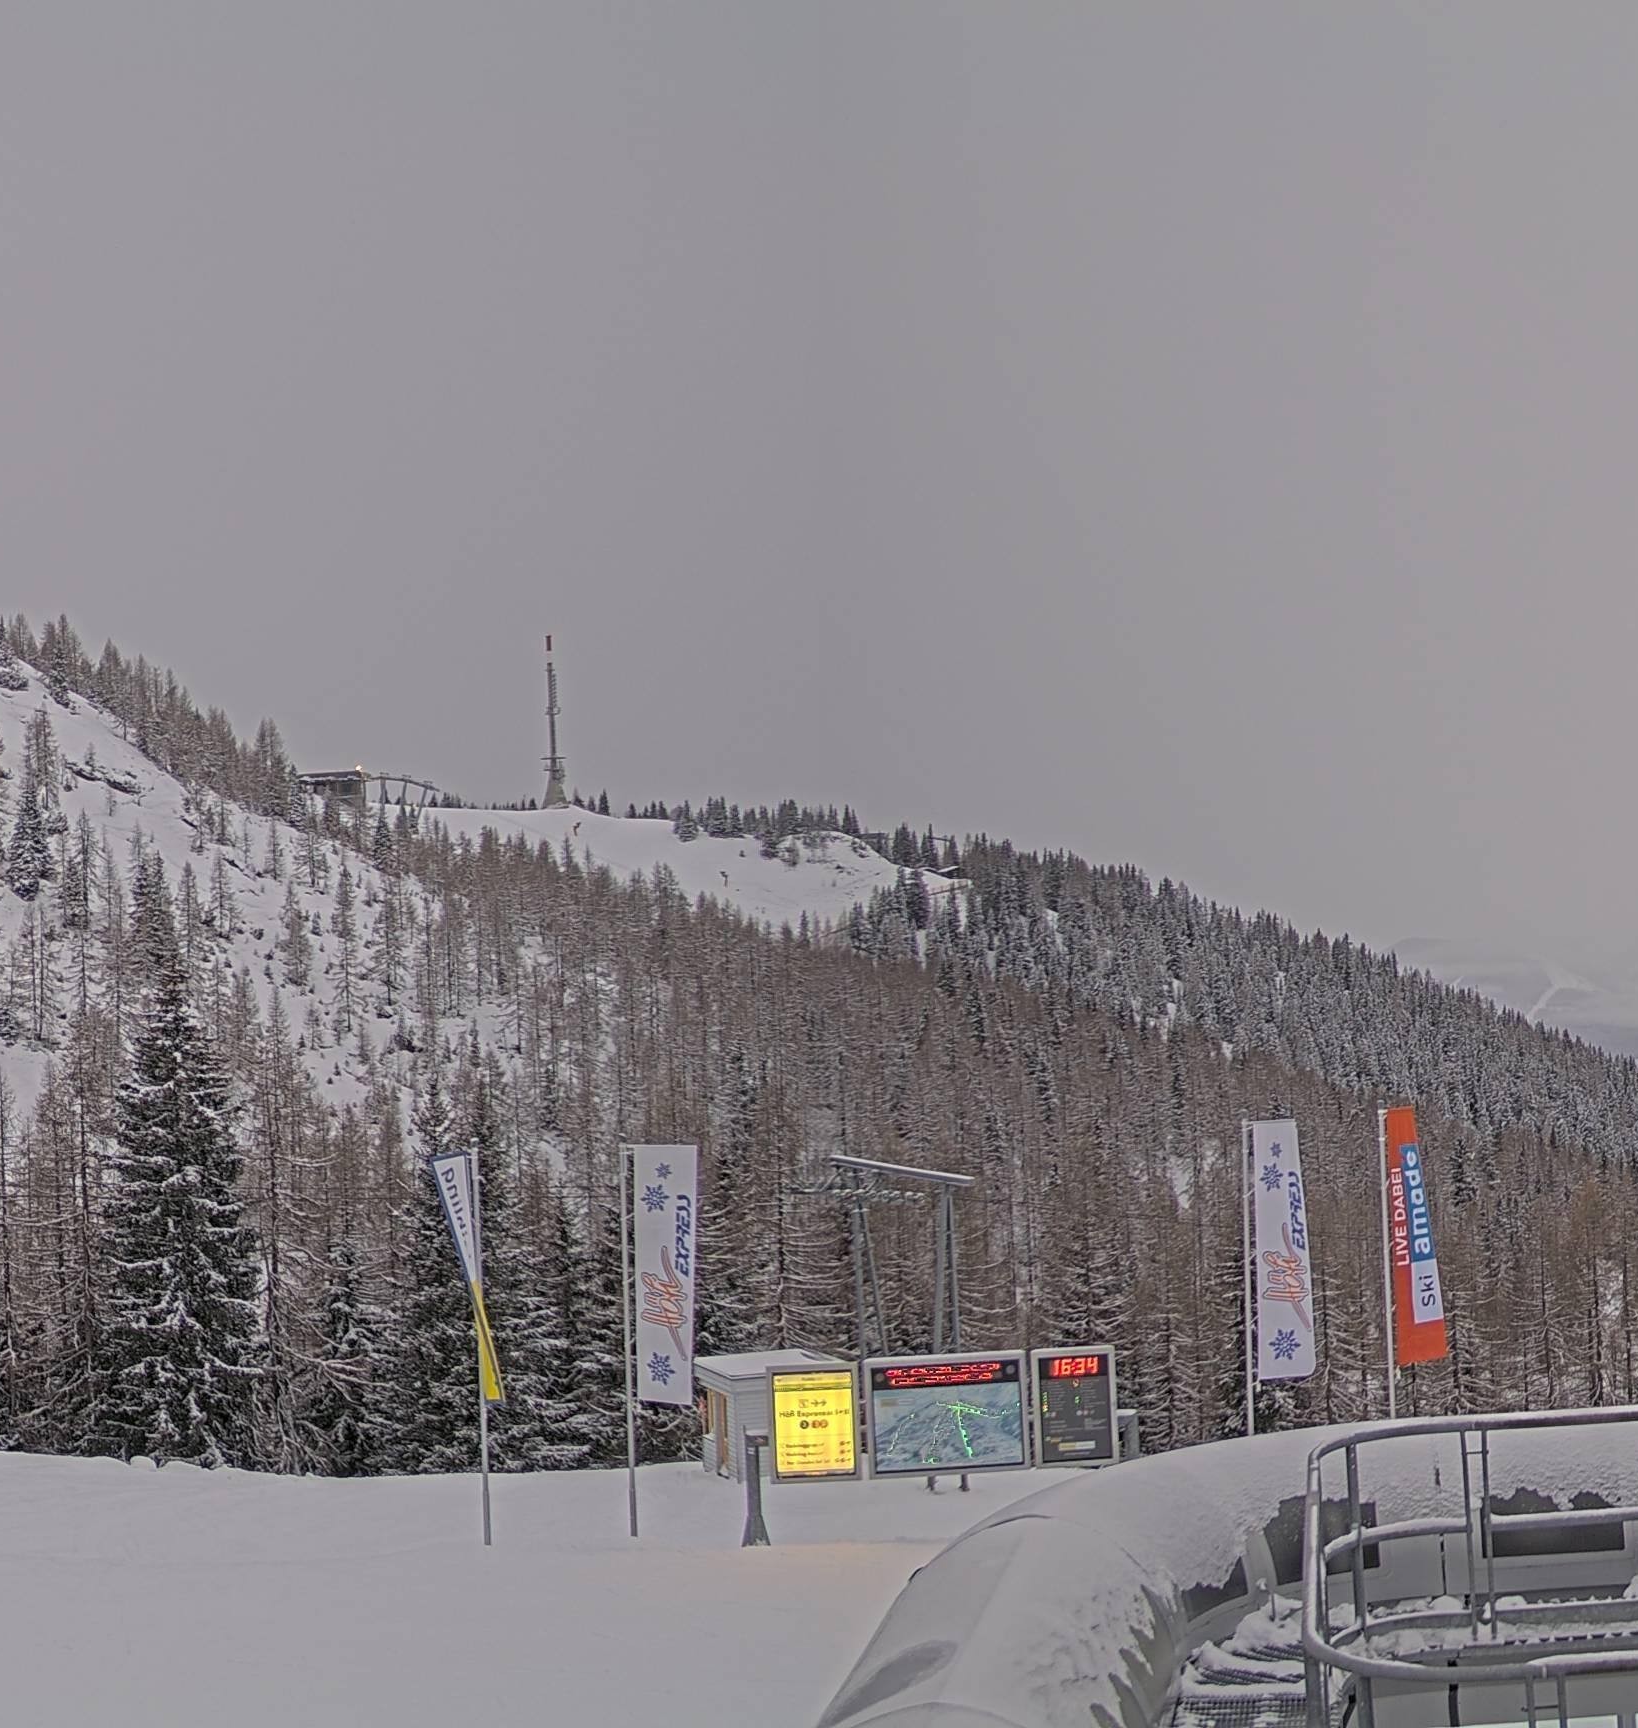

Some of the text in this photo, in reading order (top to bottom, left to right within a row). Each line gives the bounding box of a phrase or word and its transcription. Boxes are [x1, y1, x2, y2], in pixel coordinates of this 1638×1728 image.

[1390, 1168, 1410, 1267] LIVE DABEI
[1418, 1273, 1436, 1307] Ski
[1051, 1357, 1099, 1377] 16:34
